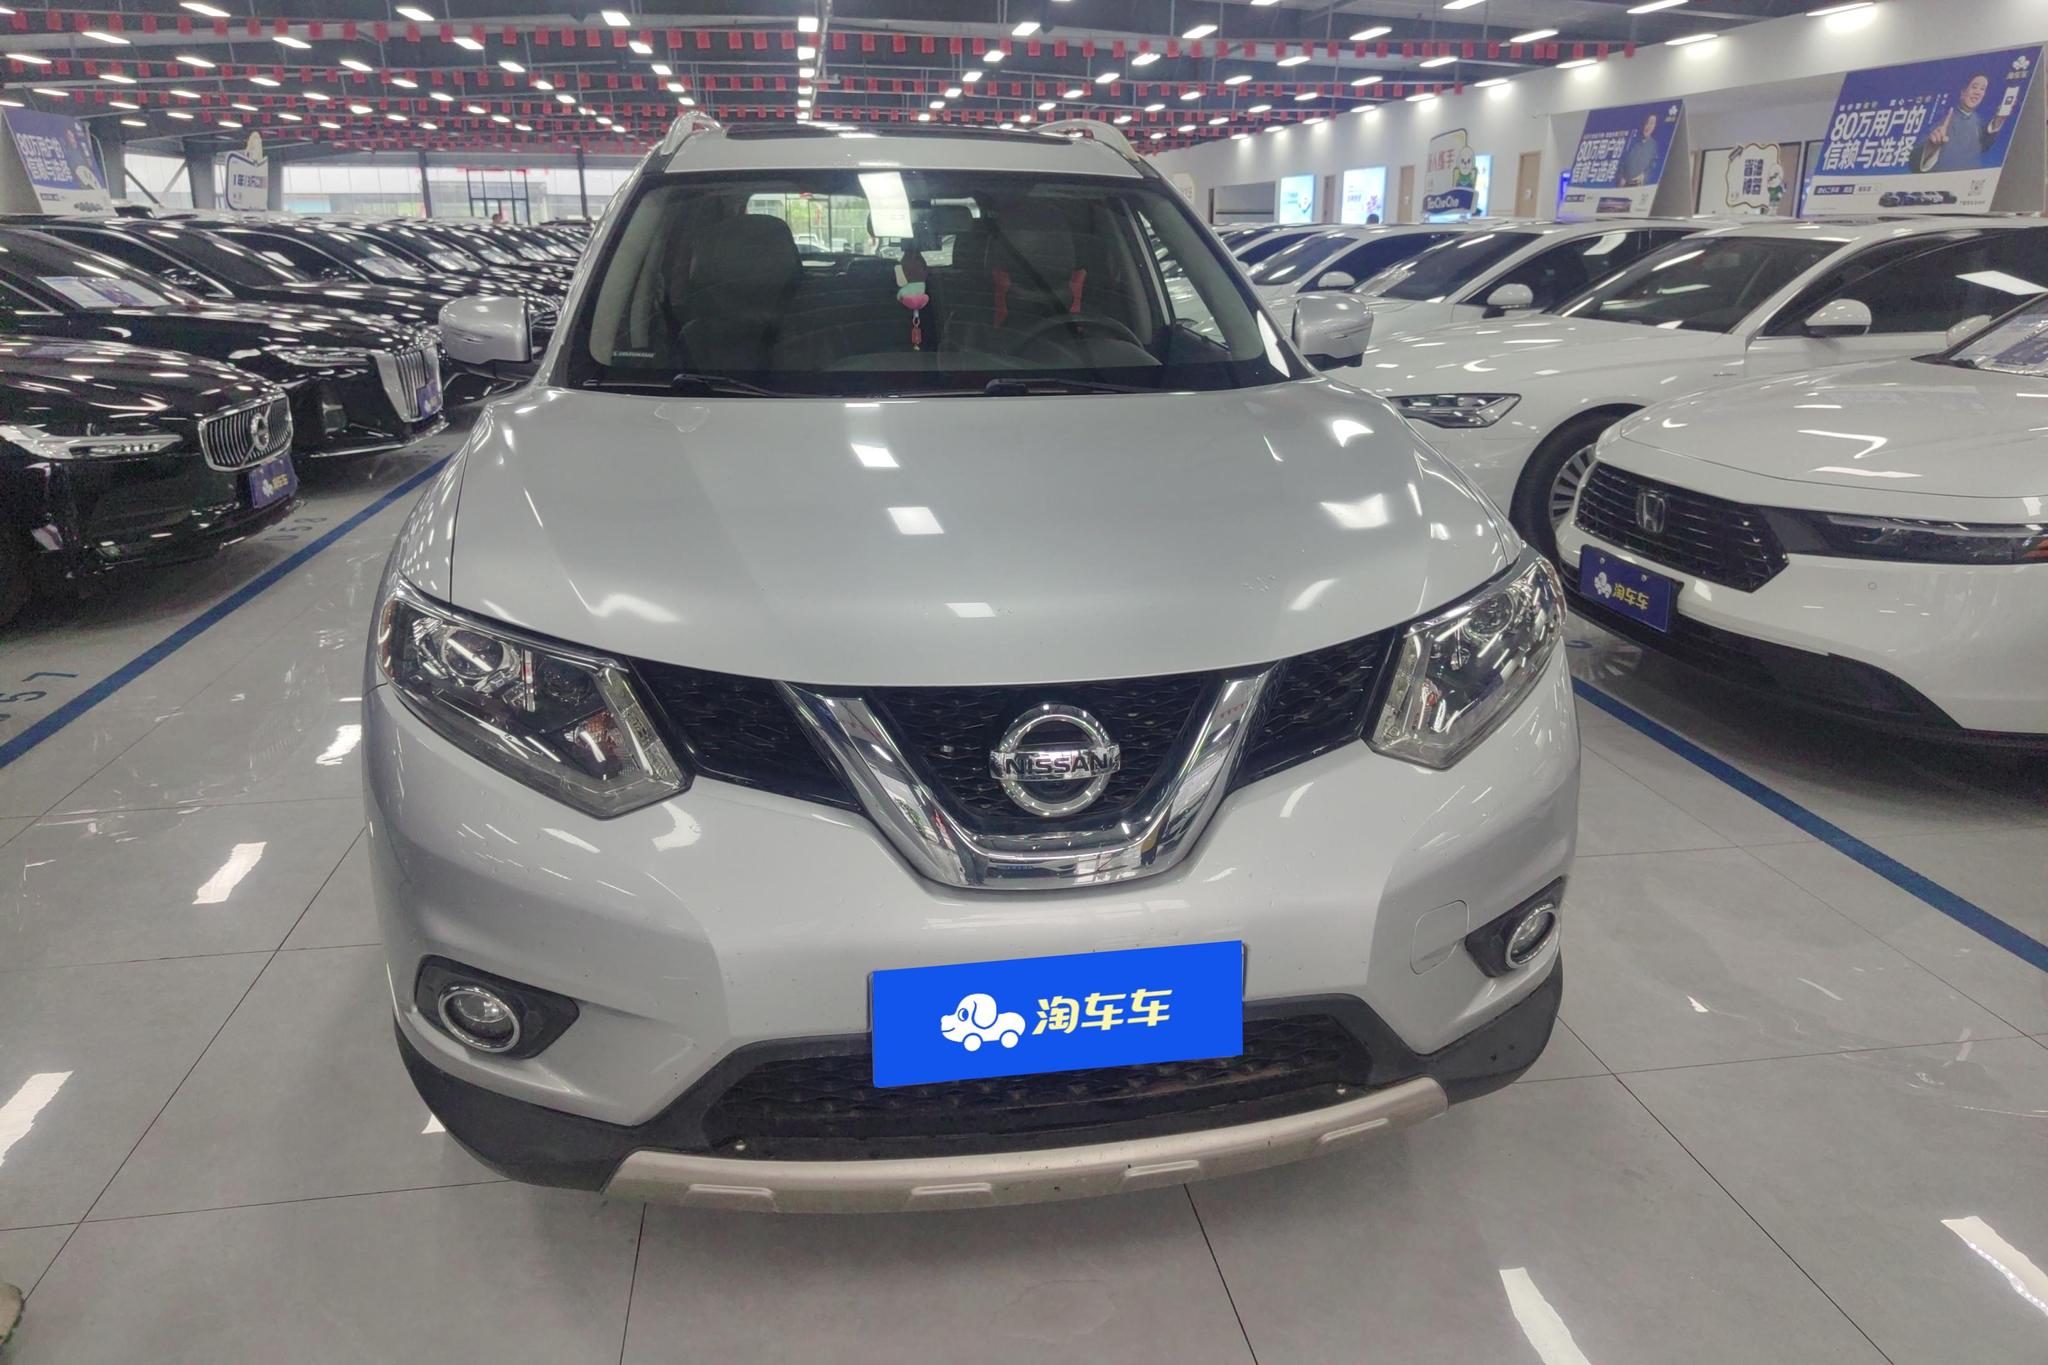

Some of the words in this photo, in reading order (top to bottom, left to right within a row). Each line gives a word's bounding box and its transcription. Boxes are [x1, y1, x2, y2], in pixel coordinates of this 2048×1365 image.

[1830, 106, 1928, 141] 80万用户的
[1576, 138, 1626, 161] 80万用户的
[1822, 136, 1917, 171] 信赖与选择
[1613, 582, 1649, 610] 淘车车
[1005, 752, 1107, 775] NISSAN
